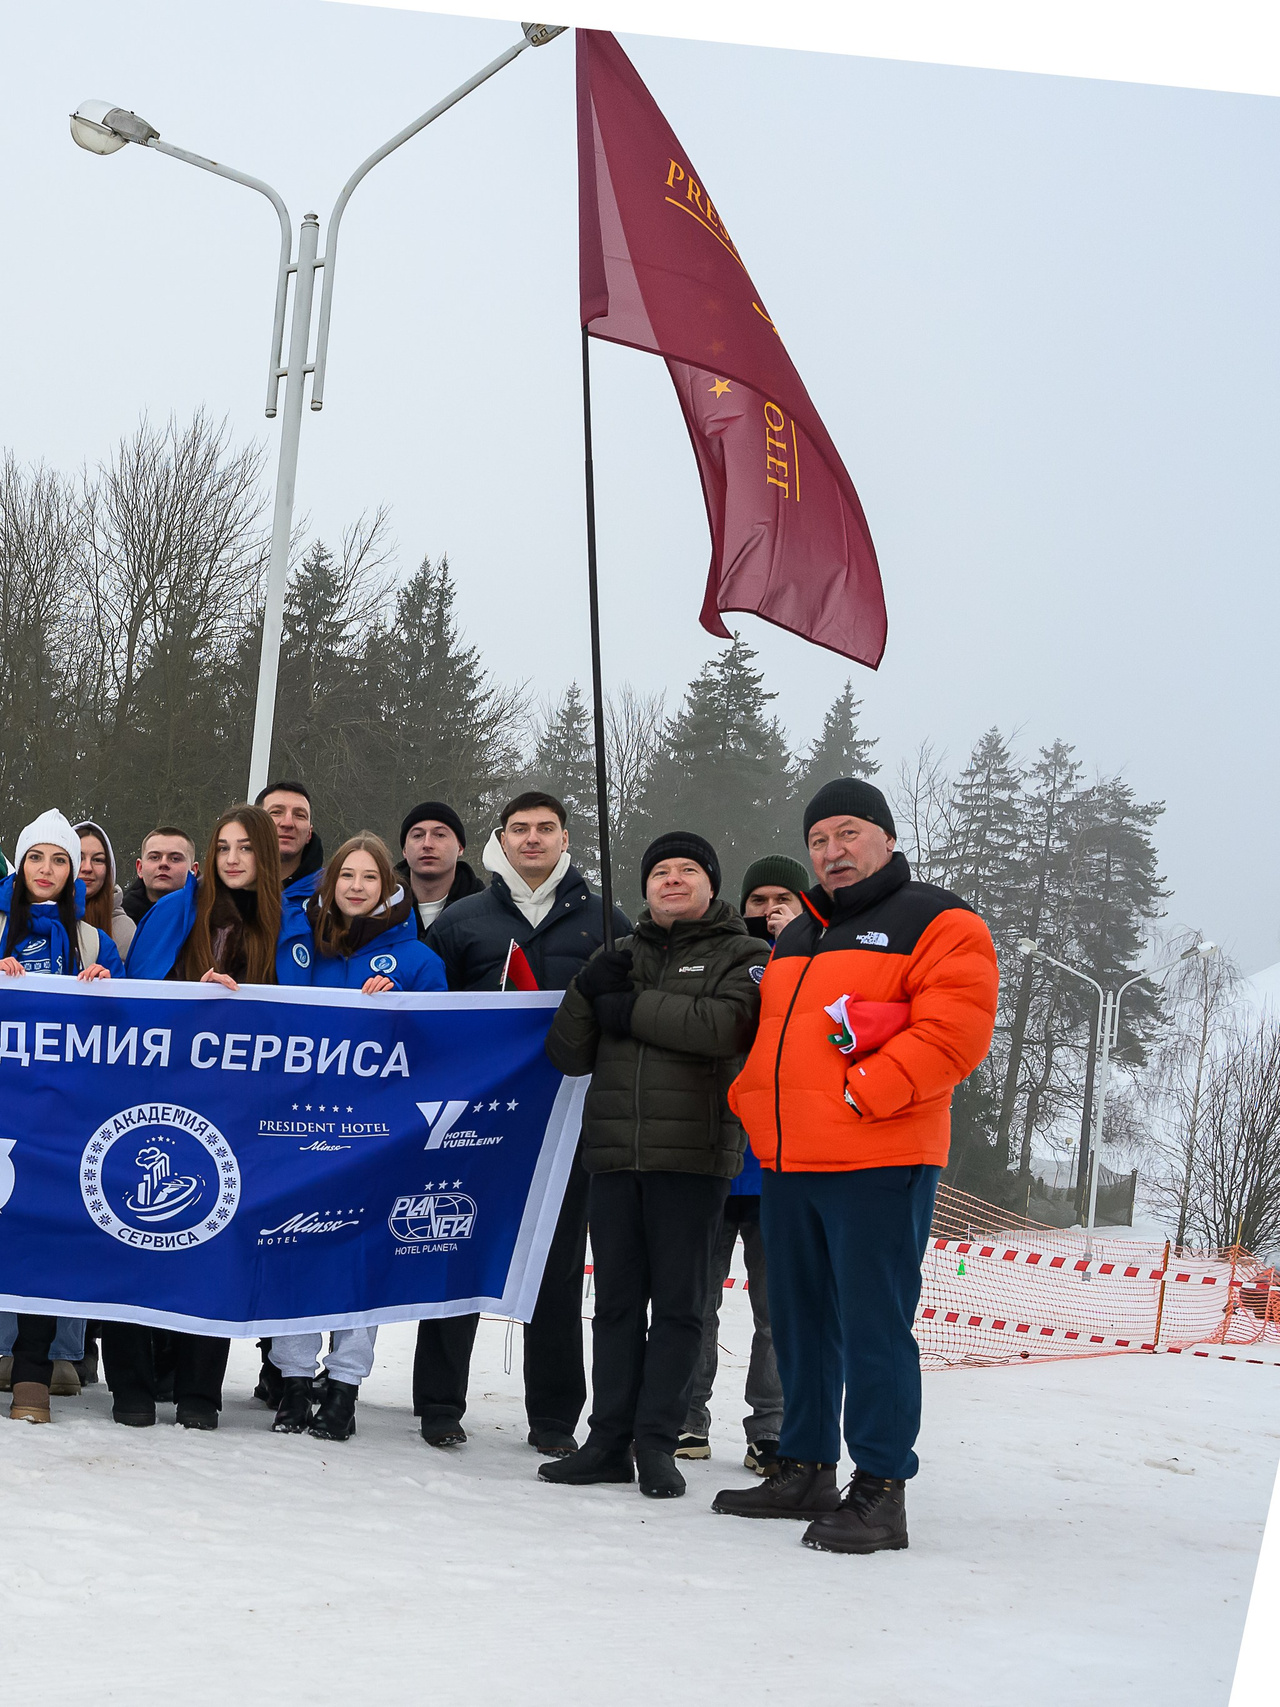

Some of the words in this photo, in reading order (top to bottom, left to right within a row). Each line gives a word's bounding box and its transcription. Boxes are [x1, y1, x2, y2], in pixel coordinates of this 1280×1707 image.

[190, 1031, 410, 1078] СЕРВИСА
[112, 1105, 210, 1137] АКАДЕМИЯ
[259, 1120, 336, 1133] PRESIDENT
[341, 1123, 390, 1133] HOTEL
[445, 1130, 478, 1140] HOTEL
[443, 1136, 503, 1149] YUBILEINY
[117, 1227, 200, 1248] СЕРВИСА
[257, 1236, 298, 1246] HOTEL
[395, 1245, 421, 1255] HOTEL
[422, 1243, 458, 1252] PLANETA
